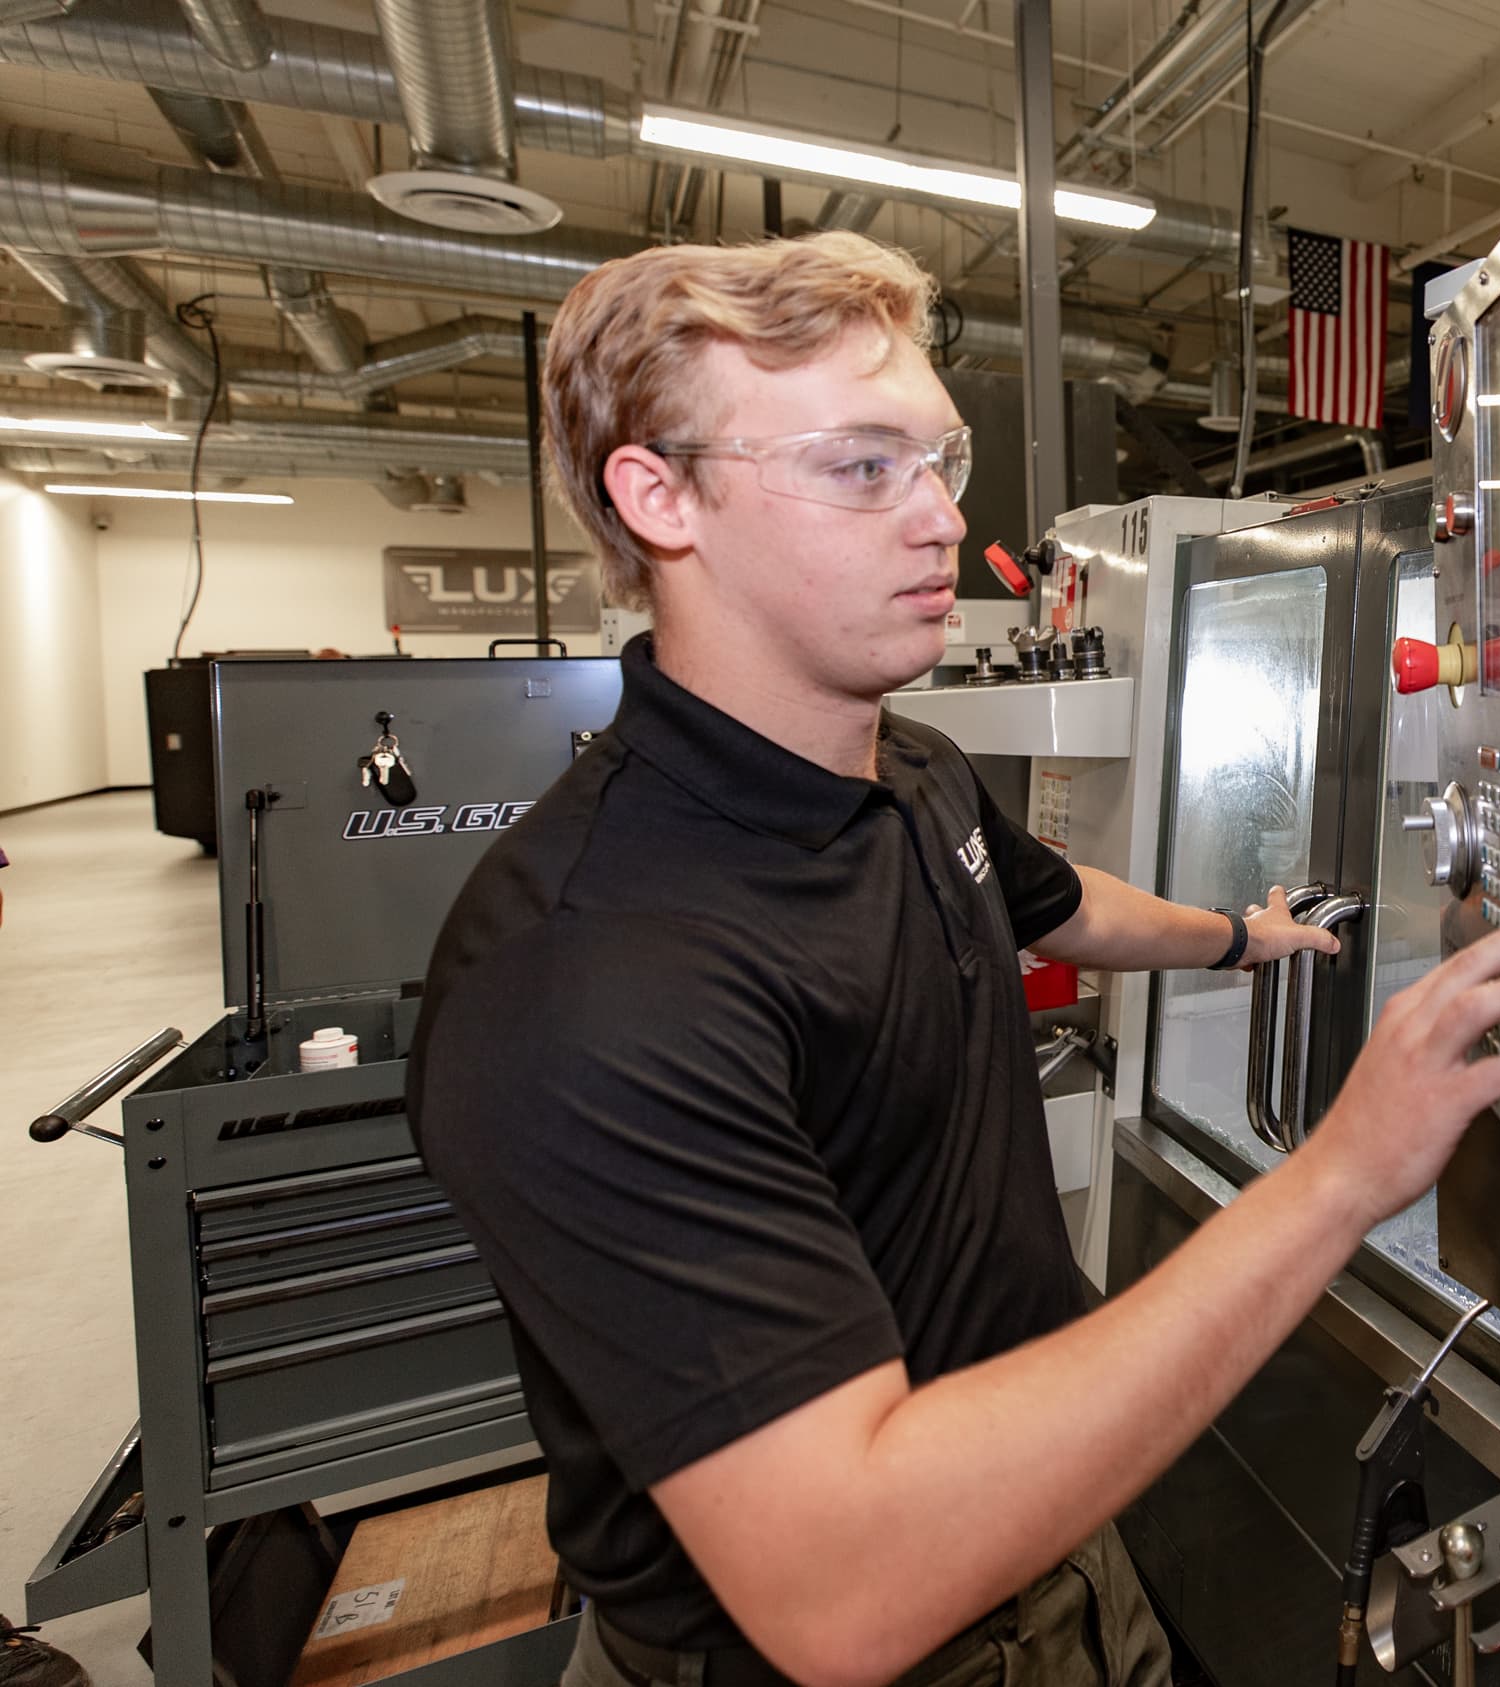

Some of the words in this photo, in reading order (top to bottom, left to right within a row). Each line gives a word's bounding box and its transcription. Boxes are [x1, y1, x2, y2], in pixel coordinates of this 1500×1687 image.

[1122, 507, 1148, 557] 115
[411, 565, 574, 603] LUX
[342, 804, 449, 840] U.S.
[293, 1097, 406, 1130] GENE
[353, 1591, 379, 1609] 51
